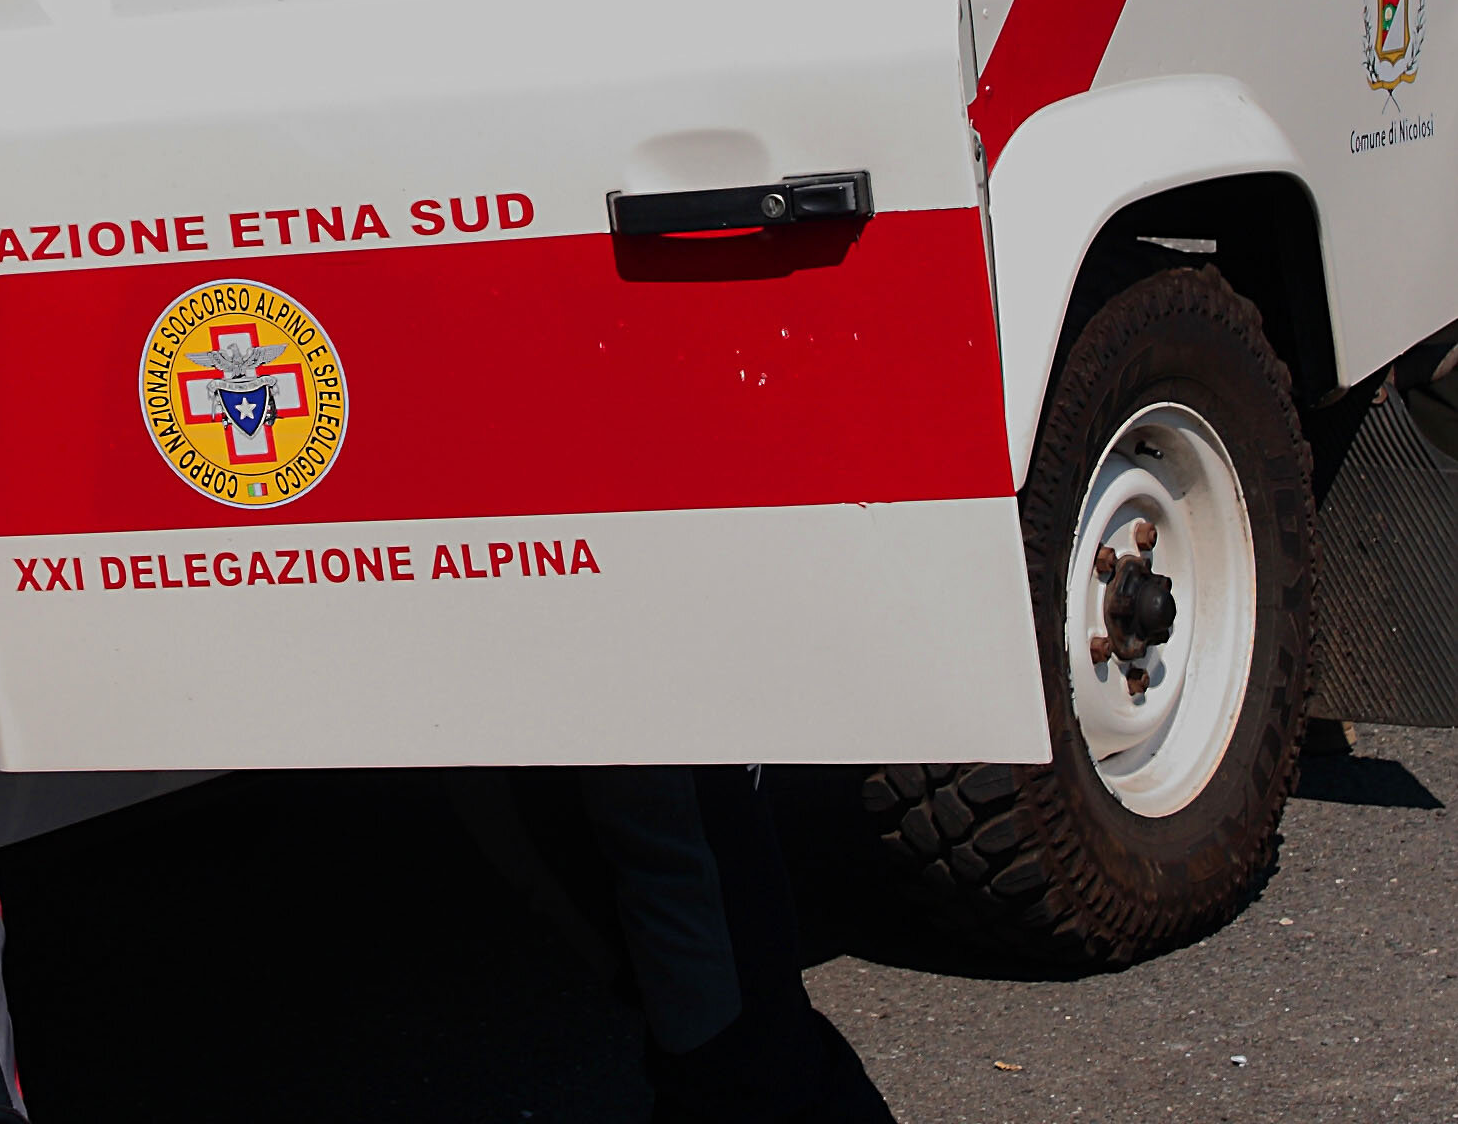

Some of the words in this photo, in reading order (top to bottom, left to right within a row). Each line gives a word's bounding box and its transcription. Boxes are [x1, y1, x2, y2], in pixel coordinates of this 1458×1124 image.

[1350, 130, 1385, 154] Comune
[1389, 120, 1397, 145] di
[1400, 113, 1433, 143] Nicolosi
[229, 203, 390, 248] ETNA
[410, 192, 535, 236] SUD
[160, 287, 250, 345] SOCCORSO
[255, 292, 315, 346] ALPINO
[307, 345, 327, 362] E
[148, 342, 186, 454] NAZIONALE
[274, 363, 341, 495] SPELEOLOGICO
[179, 449, 238, 498] CORPO
[13, 557, 85, 592] XXI
[101, 545, 415, 590] DELEGAZIONE
[432, 539, 601, 580] ALPINA
